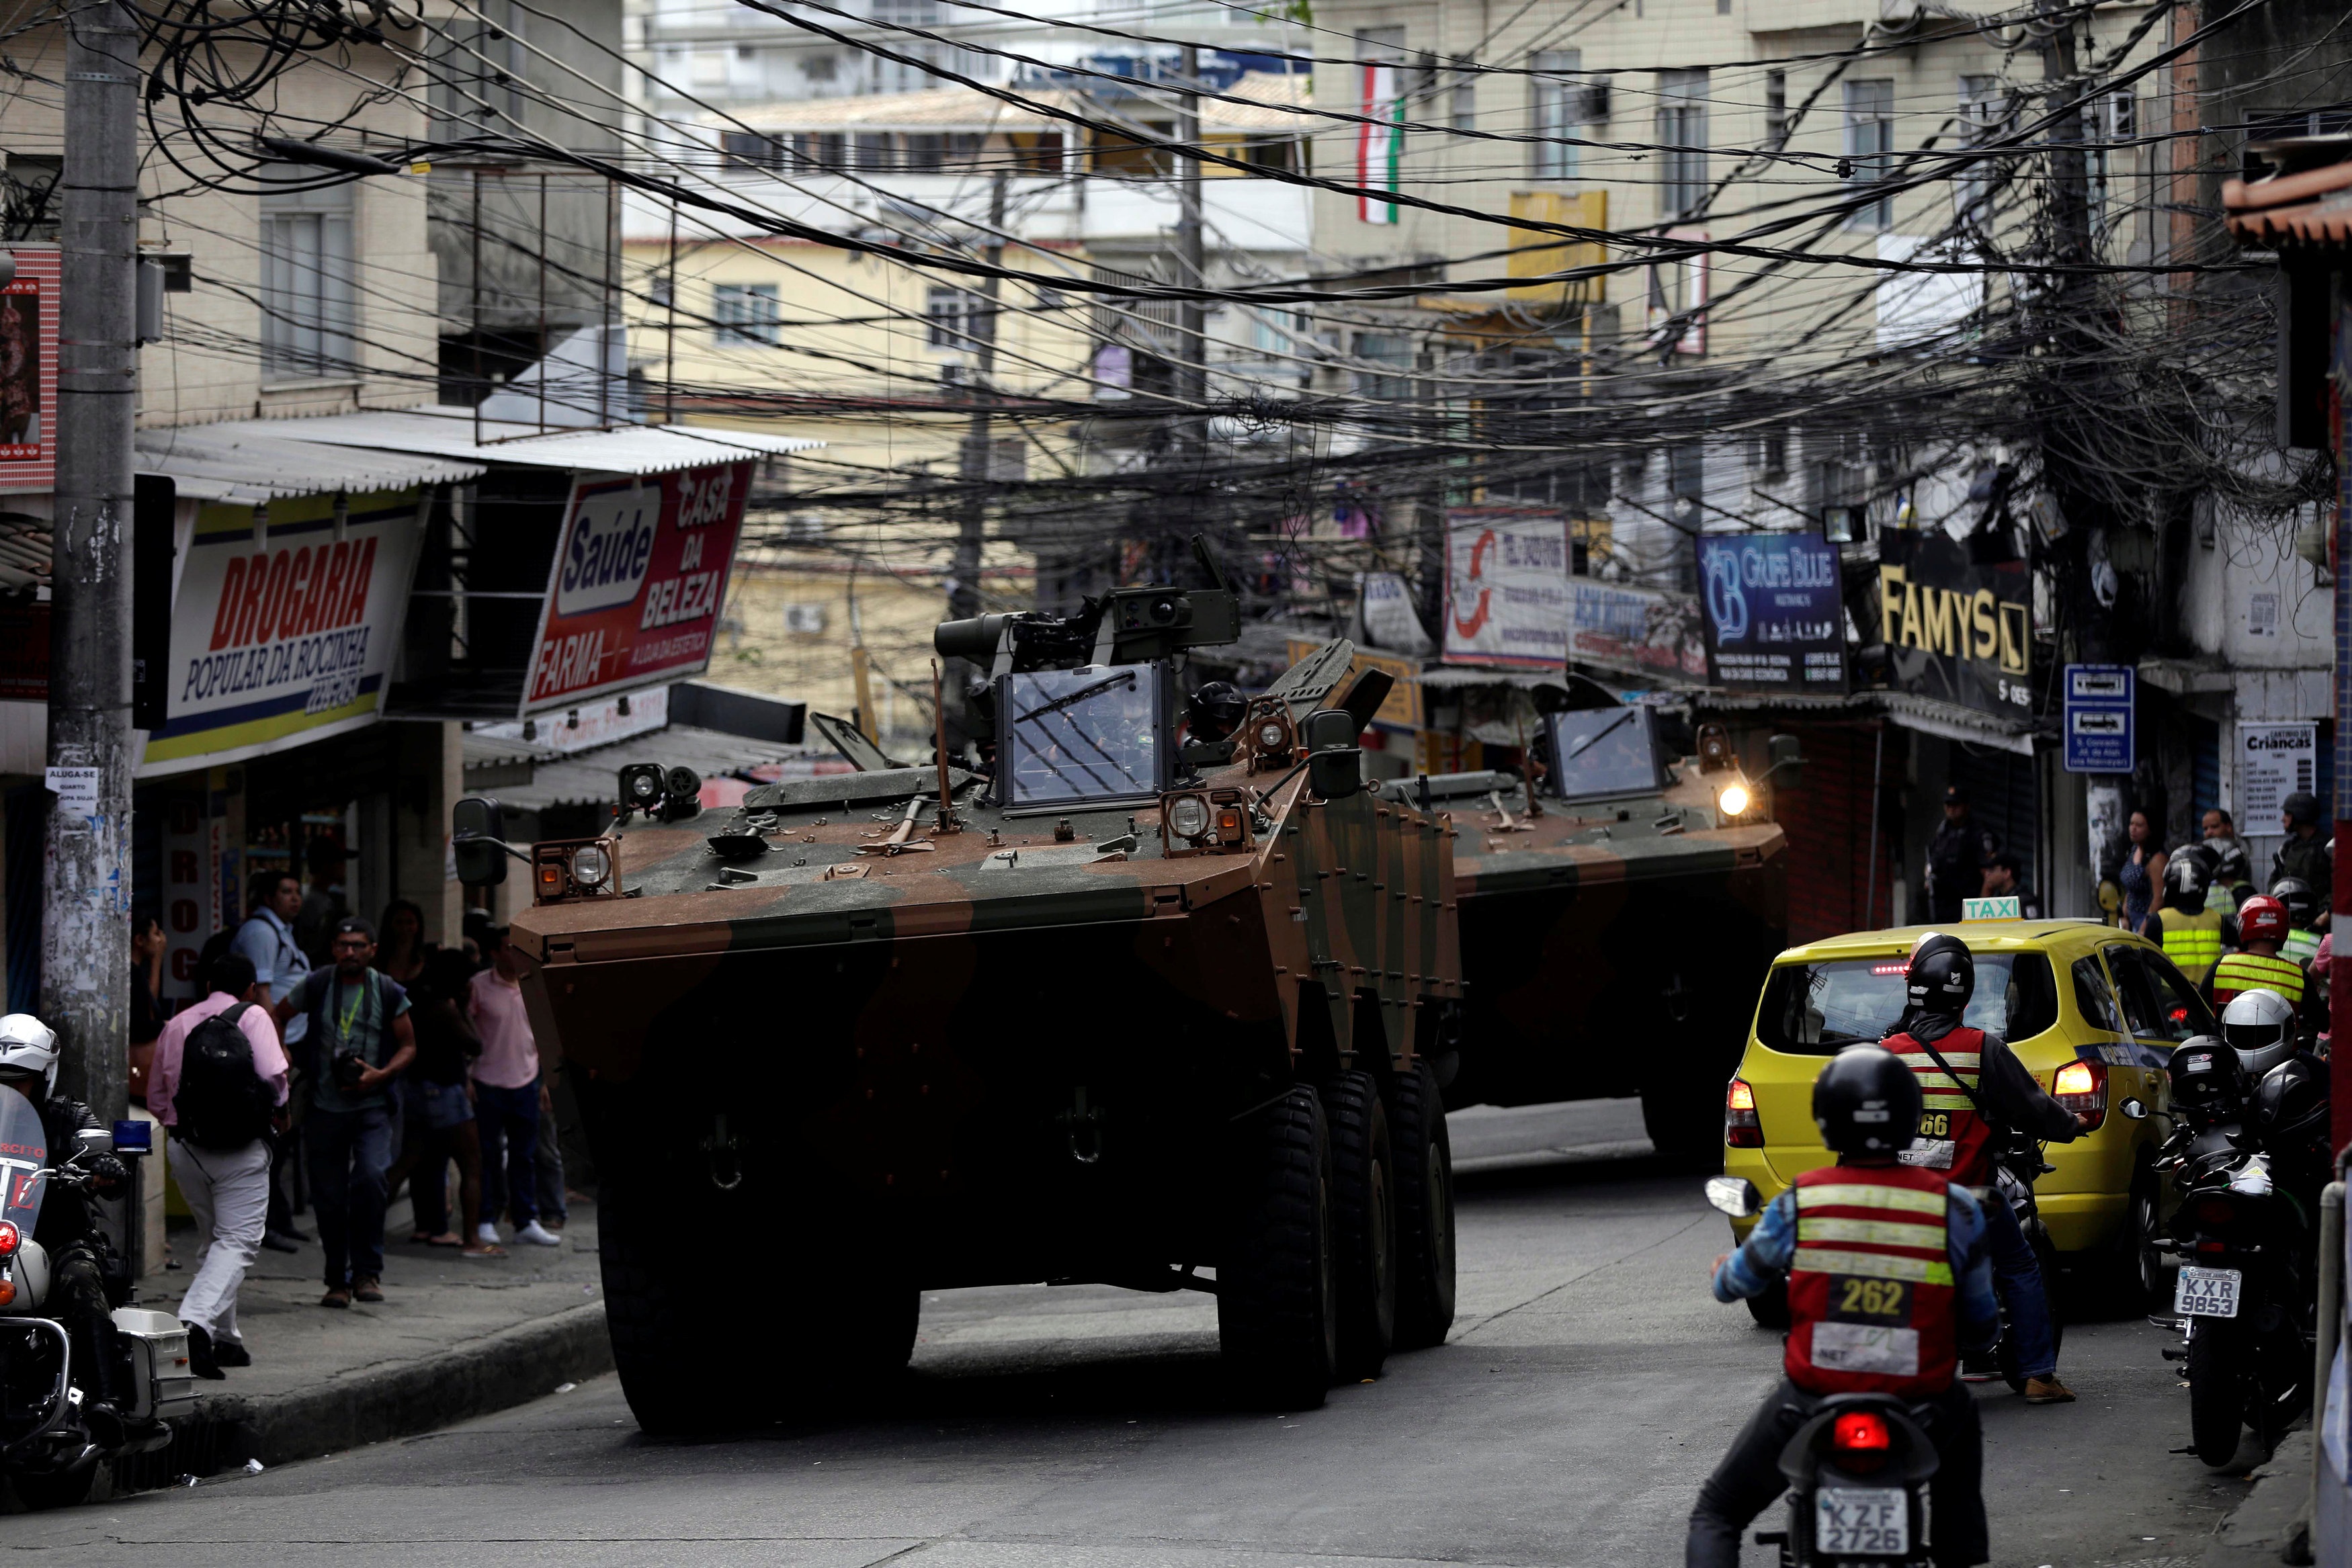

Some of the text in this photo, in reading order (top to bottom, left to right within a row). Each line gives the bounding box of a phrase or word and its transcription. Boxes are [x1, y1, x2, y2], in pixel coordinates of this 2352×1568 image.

[677, 476, 733, 529] CASA
[563, 509, 652, 593] Saúde
[679, 533, 704, 571] DA
[1790, 547, 1835, 588] BLUE
[209, 536, 378, 652] DROGARIA
[640, 570, 720, 631] BELEZA
[1879, 563, 1999, 661] FAMYS
[182, 646, 269, 702] POPULAR
[265, 642, 294, 688] DA
[293, 626, 371, 681] ROCINHA
[531, 630, 605, 697] FARMA
[170, 799, 200, 1004] DROG
[1966, 899, 2019, 919] TAXI
[1915, 1113, 1949, 1137] 66
[0, 1143, 46, 1159] RCITO
[7, 1174, 38, 1210] E
[1840, 1278, 1904, 1316] 262
[2181, 1295, 2233, 1315] 9853
[2185, 1278, 2232, 1299] KXR
[1818, 1348, 1846, 1362] NET
[1829, 1504, 1895, 1527] KZF
[1827, 1529, 1900, 1550] 2726
